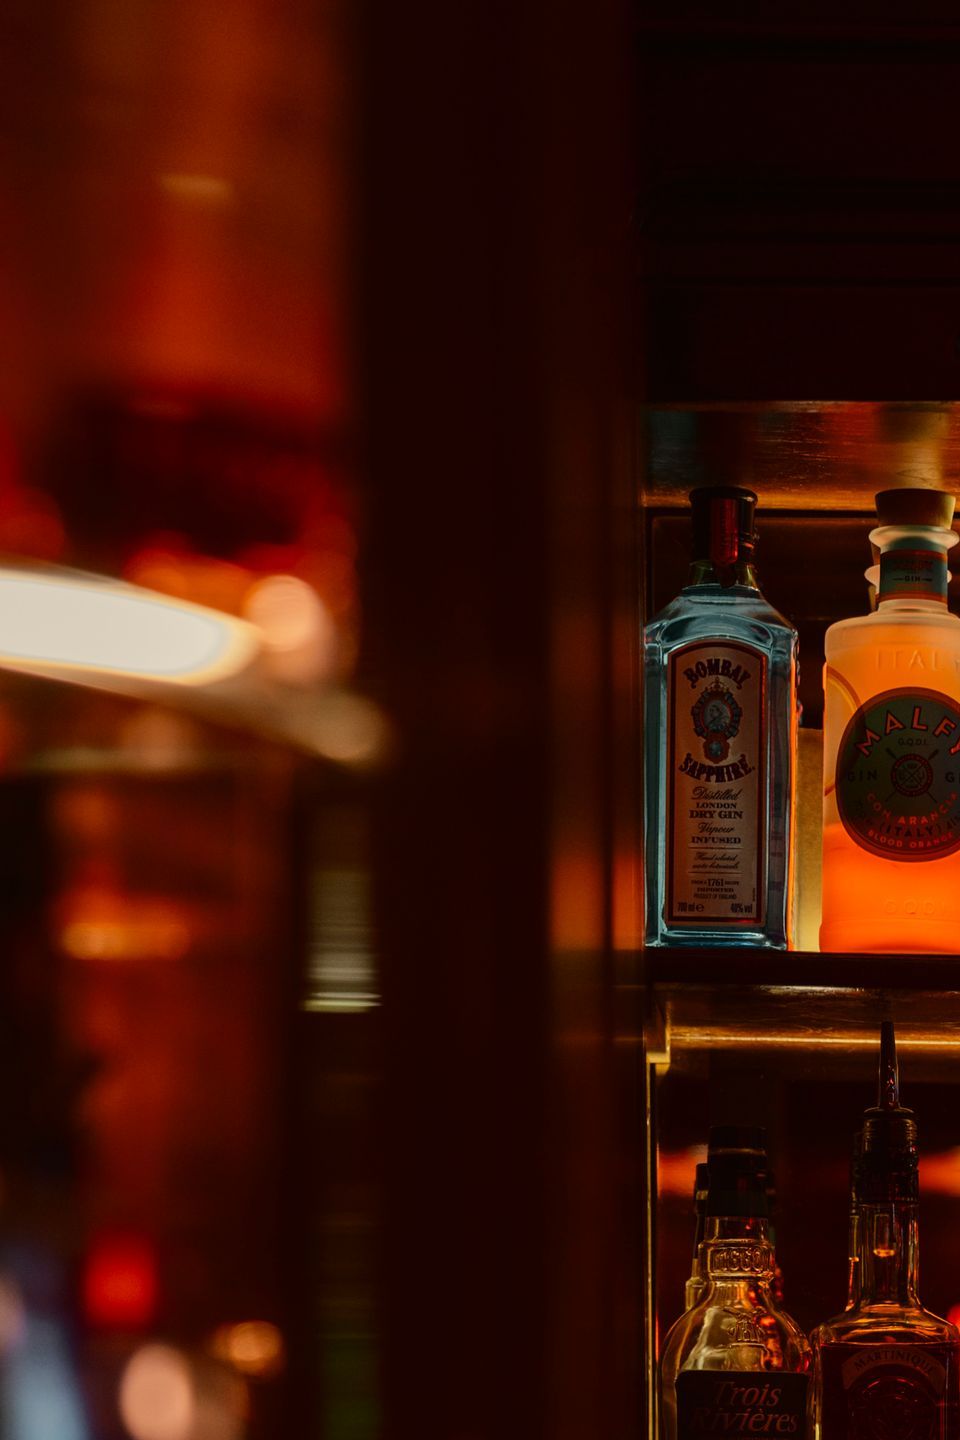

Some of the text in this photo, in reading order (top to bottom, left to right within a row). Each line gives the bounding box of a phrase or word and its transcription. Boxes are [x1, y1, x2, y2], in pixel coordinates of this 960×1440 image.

[684, 658, 751, 689] BOMBAY
[847, 769, 879, 782] GIN
[691, 786, 743, 800] Distilled
[689, 810, 744, 819] DRY GIN
[691, 836, 741, 844] INFUSED
[854, 1350, 935, 1373] MARTINIQUE
[714, 1380, 783, 1407] Trois
[689, 1407, 801, 1433] Rivières
